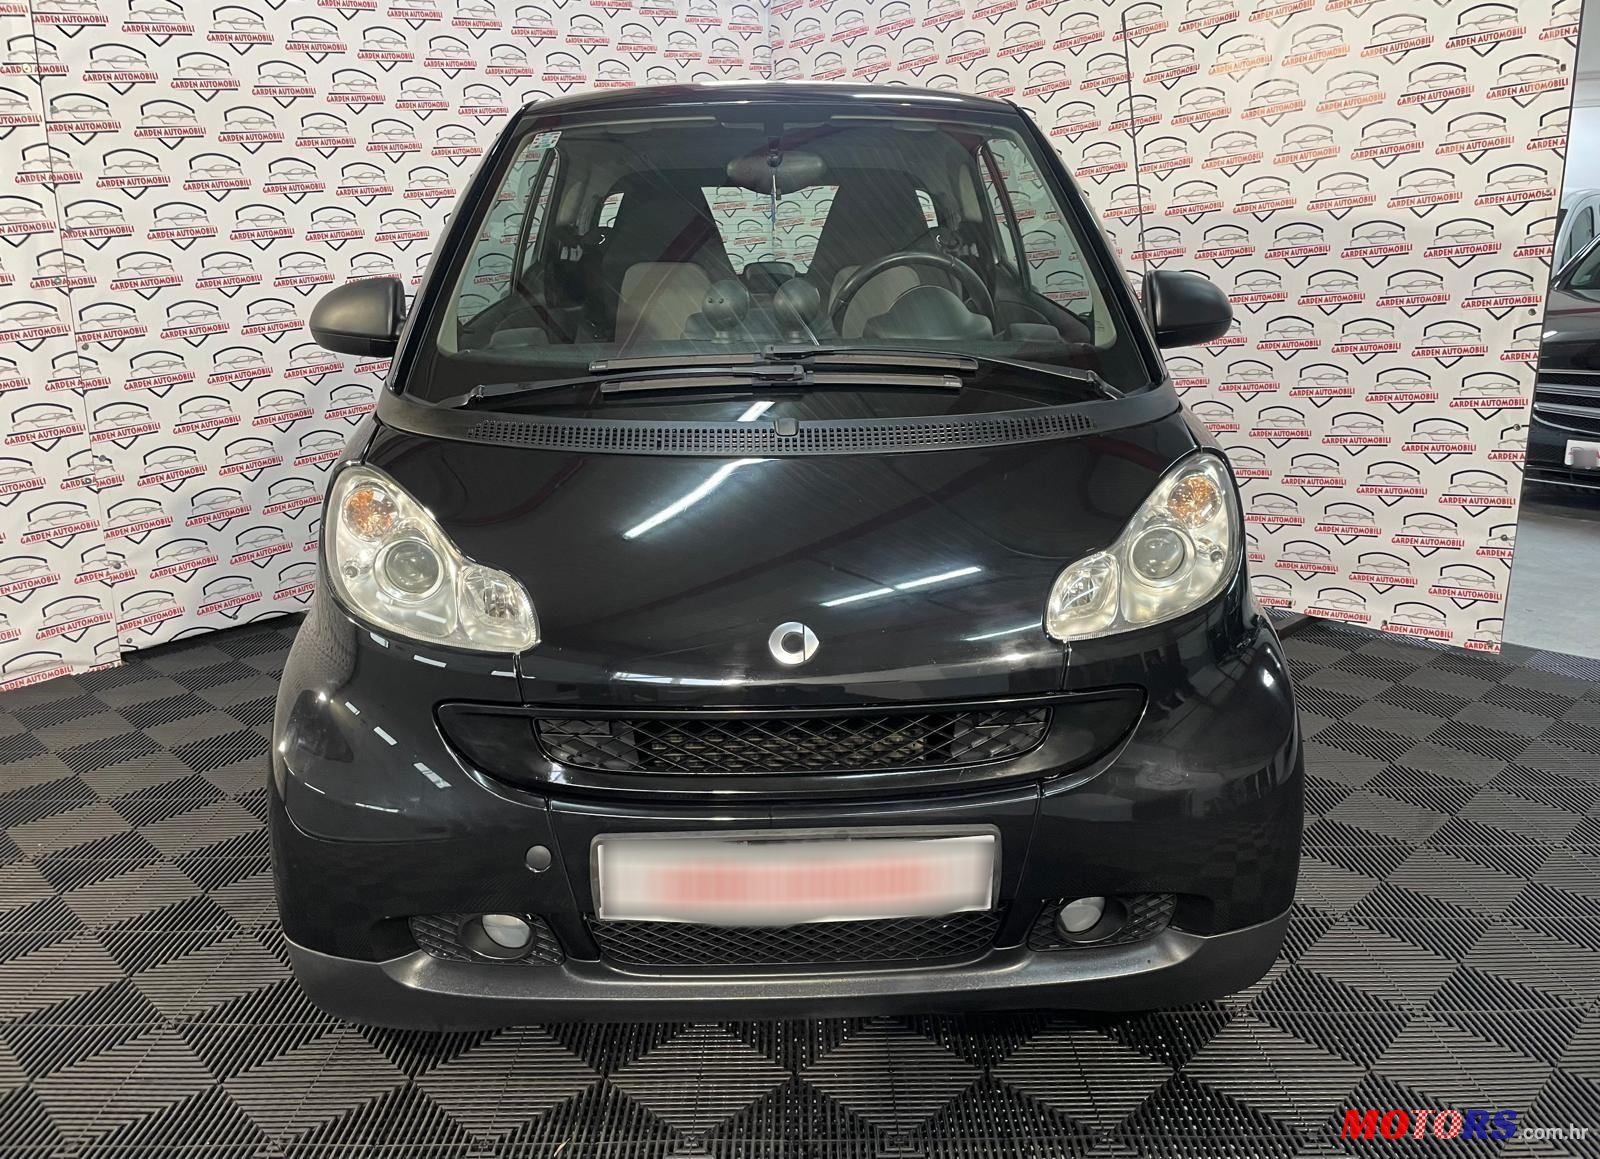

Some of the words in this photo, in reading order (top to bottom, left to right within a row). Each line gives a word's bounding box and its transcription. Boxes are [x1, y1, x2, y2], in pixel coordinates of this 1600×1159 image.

[1179, 20, 1202, 33] GARDEN
[1203, 10, 1240, 27] AUTOMOBILI
[121, 25, 151, 33] GARDEN
[152, 24, 193, 32] AUTOMOBILI
[1445, 36, 1476, 50] GARDEN
[1478, 26, 1526, 43] AUTOMOBILI
[311, 43, 347, 51] AUTOMOBILI
[82, 73, 112, 81] GARDEN
[114, 72, 159, 81] AUTOMOBILI
[170, 81, 198, 89] GARDEN
[199, 79, 240, 88] AUTOMOBILI
[1486, 86, 1518, 99] GARDEN
[1519, 78, 1568, 94] AUTOMOBILI
[252, 88, 278, 96] GARDEN
[278, 87, 315, 95] AUTOMOBILI
[1397, 93, 1426, 106] GARDEN
[1428, 85, 1474, 101] AUTOMOBILI
[134, 129, 163, 137] GARDEN
[164, 127, 206, 136] AUTOMOBILI
[218, 134, 244, 142] GARDEN
[245, 132, 283, 141] AUTOMOBILI
[295, 139, 320, 147] GARDEN
[320, 138, 356, 146] AUTOMOBILI
[1435, 143, 1465, 155] GARDEN
[1466, 135, 1514, 150] AUTOMOBILI
[96, 178, 126, 188] GARDEN
[127, 176, 171, 186] AUTOMOBILI
[183, 182, 210, 191] GARDEN
[211, 179, 251, 189] AUTOMOBILI
[263, 185, 288, 193] GARDEN
[288, 182, 326, 191] AUTOMOBILI
[336, 188, 359, 196] GARDEN
[360, 185, 394, 194] AUTOMOBILI
[1387, 198, 1415, 208] GARDEN
[1417, 192, 1463, 205] AUTOMOBILI
[147, 230, 175, 240] GARDEN
[176, 226, 217, 237] AUTOMOBILI
[230, 231, 256, 240] GARDEN
[256, 227, 295, 238] AUTOMOBILI
[305, 232, 329, 241] GARDEN
[330, 229, 363, 239] AUTOMOBILI
[1264, 249, 1289, 259] GARDEN
[1290, 244, 1331, 256] AUTOMOBILI
[1340, 249, 1368, 259] GARDEN
[1369, 244, 1413, 255] AUTOMOBILI
[1423, 248, 1453, 258] GARDEN
[1455, 242, 1502, 255] AUTOMOBILI
[110, 280, 139, 291] GARDEN
[140, 275, 183, 287] AUTOMOBILI
[195, 279, 222, 289] GARDEN
[223, 273, 263, 286] AUTOMOBILI
[273, 278, 298, 288] GARDEN
[299, 273, 335, 284] AUTOMOBILI
[1297, 296, 1323, 305] GARDEN
[1324, 293, 1365, 303] AUTOMOBILI
[1376, 298, 1405, 307] GARDEN
[1406, 294, 1450, 305] AUTOMOBILI
[1461, 299, 1492, 308] GARDEN
[1493, 295, 1541, 306] AUTOMOBILI
[160, 328, 188, 339] GARDEN
[189, 322, 230, 335] AUTOMOBILI
[241, 325, 266, 336] GARDEN
[267, 319, 304, 332] AUTOMOBILI
[1256, 342, 1281, 350] GARDEN
[1282, 339, 1321, 349] AUTOMOBILI
[1331, 345, 1358, 353] GARDEN
[1359, 342, 1401, 352] AUTOMOBILI
[1411, 348, 1440, 357] GARDEN
[1442, 346, 1488, 355] AUTOMOBILI
[124, 379, 152, 391] GARDEN
[153, 371, 196, 386] AUTOMOBILI
[207, 373, 233, 385] GARDEN
[234, 366, 273, 380] AUTOMOBILI
[1218, 384, 1242, 392] GARDEN
[1242, 382, 1280, 391] AUTOMOBILI
[1289, 389, 1314, 397] GARDEN
[1315, 387, 1355, 396] AUTOMOBILI
[1365, 394, 1393, 402] GARDEN
[1394, 392, 1439, 401] AUTOMOBILI
[1449, 400, 1479, 408] GARDEN
[1481, 398, 1528, 407] AUTOMOBILI
[252, 415, 277, 427] GARDEN
[278, 408, 314, 422] AUTOMOBILI
[173, 423, 200, 435] GARDEN
[201, 414, 241, 429] AUTOMOBILI
[4, 432, 37, 446] GARDEN
[38, 423, 86, 439] AUTOMOBILI
[1401, 444, 1429, 452] GARDEN
[219, 464, 245, 476] GARDEN
[245, 455, 283, 470] AUTOMOBILI
[137, 474, 165, 487] GARDEN
[166, 464, 207, 481] AUTOMOBILI
[1307, 478, 1347, 486] AUTOMOBILI
[1384, 487, 1427, 495] AUTOMOBILI
[1439, 496, 1467, 504] GARDEN
[1469, 497, 1515, 505] AUTOMOBILI
[185, 514, 212, 527] GARDEN
[213, 505, 251, 520] AUTOMOBILI
[20, 530, 52, 545] GARDEN
[53, 519, 100, 537] AUTOMOBILI
[1314, 525, 1339, 533] GARDEN
[1340, 526, 1381, 535] AUTOMOBILI
[1391, 537, 1419, 545] GARDEN
[1420, 538, 1464, 547] AUTOMOBILI
[150, 566, 177, 579] GARDEN
[178, 555, 219, 572] AUTOMOBILI
[1300, 563, 1338, 572] AUTOMOBILI
[1348, 574, 1375, 582] GARDEN
[1376, 576, 1418, 585] AUTOMOBILI
[1428, 587, 1456, 596] GARDEN
[1457, 590, 1502, 600] AUTOMOBILI
[197, 602, 223, 616] GARDEN
[224, 590, 263, 608] AUTOMOBILI
[36, 625, 66, 640] GARDEN
[67, 611, 113, 631] AUTOMOBILI
